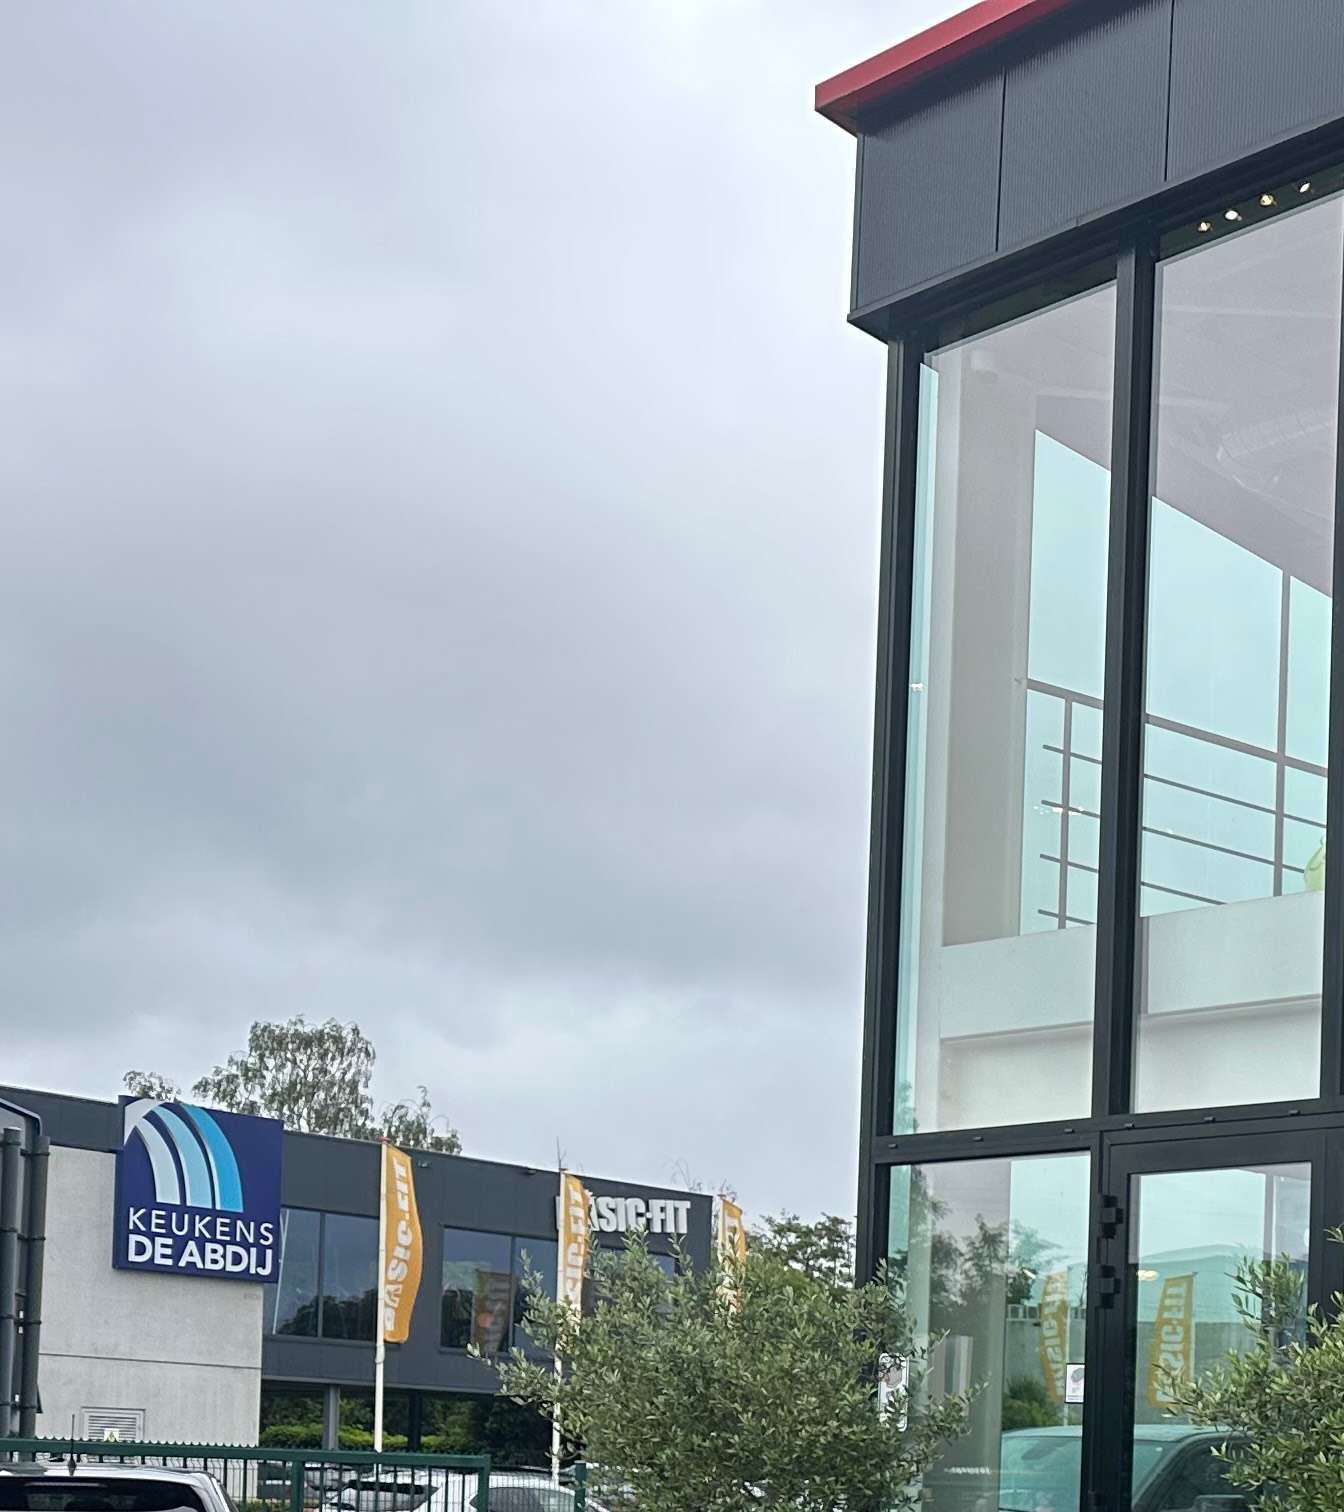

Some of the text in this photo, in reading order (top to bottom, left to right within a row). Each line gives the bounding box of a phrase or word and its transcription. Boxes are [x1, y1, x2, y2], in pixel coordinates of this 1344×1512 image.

[129, 1207, 274, 1246] KEUKENS
[128, 1233, 273, 1276] DE ABDIJ
